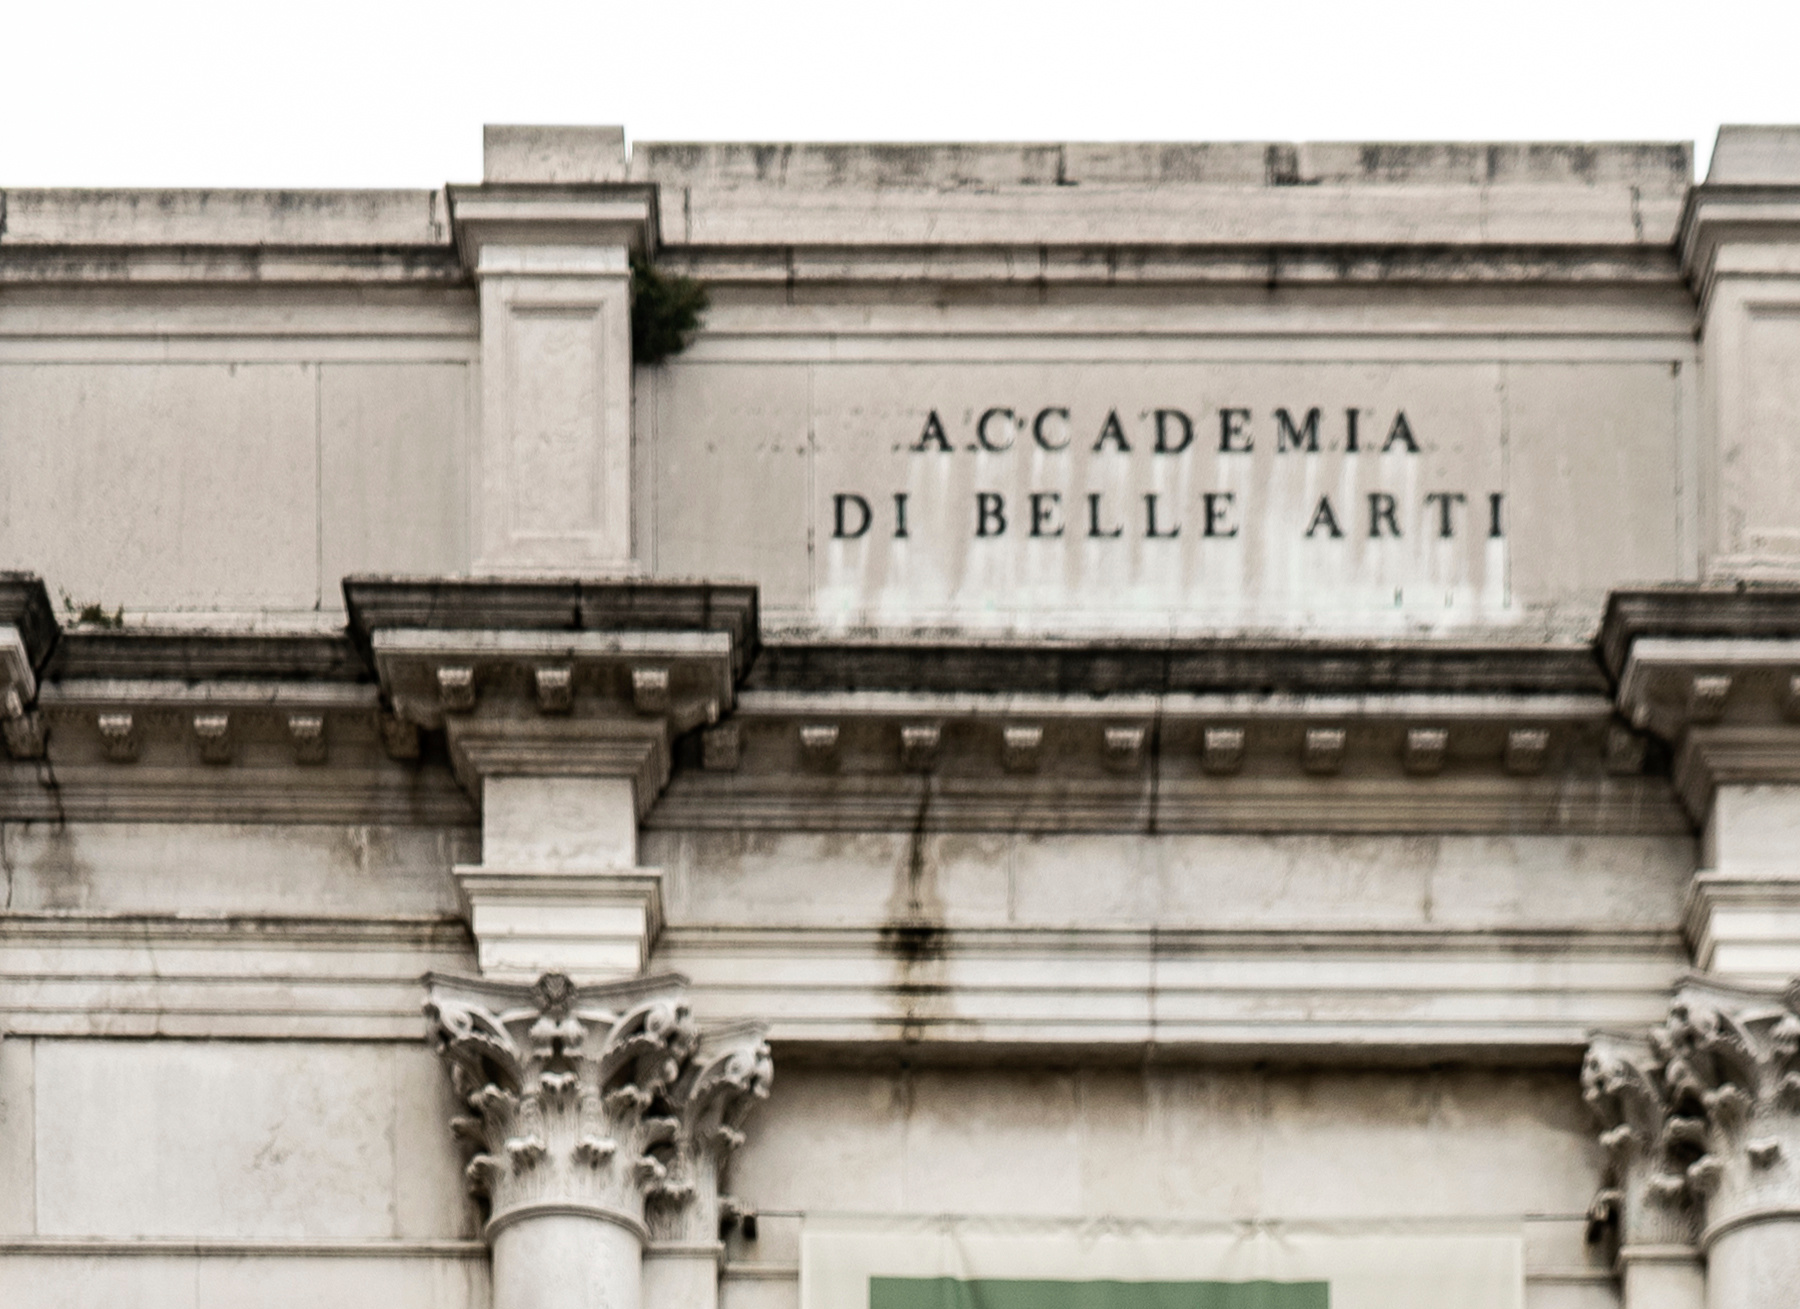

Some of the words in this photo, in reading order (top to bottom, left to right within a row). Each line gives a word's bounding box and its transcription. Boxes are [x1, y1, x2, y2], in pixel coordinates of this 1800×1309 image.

[916, 407, 1423, 454] ACCADEMIA
[831, 492, 912, 540] DI
[974, 492, 1240, 539] BELLE
[1304, 493, 1508, 539] ARTI
